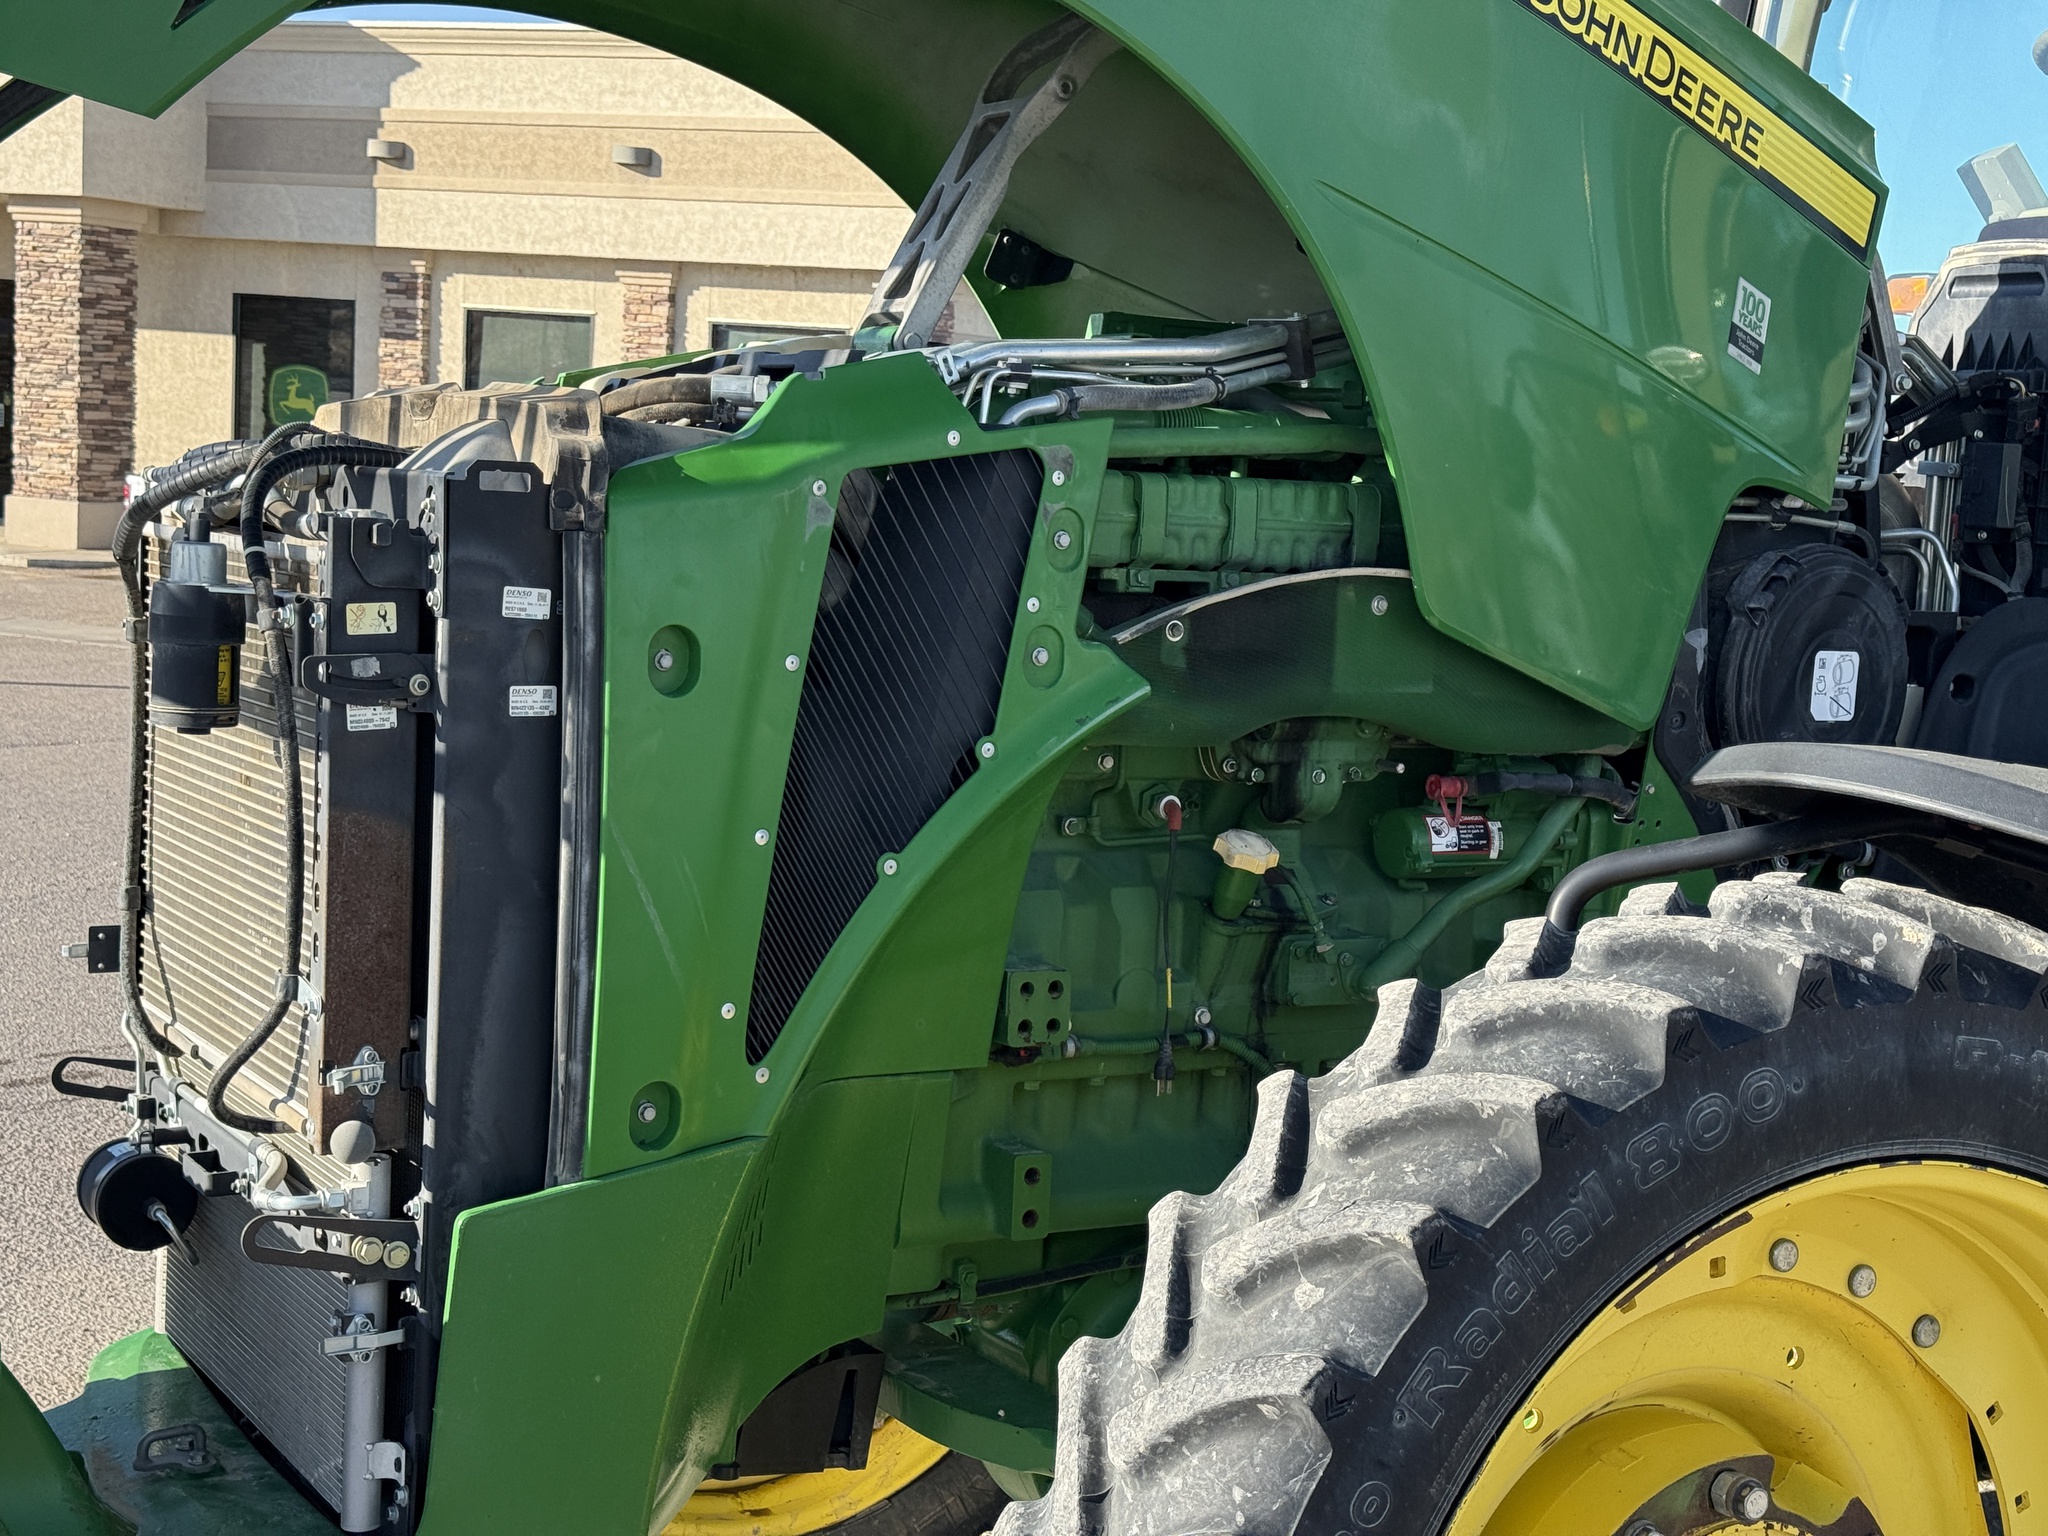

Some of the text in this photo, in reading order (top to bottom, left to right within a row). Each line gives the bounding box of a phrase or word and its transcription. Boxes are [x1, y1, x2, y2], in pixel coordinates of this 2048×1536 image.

[1741, 285, 1766, 323] 100
[1738, 309, 1763, 338] YEARS
[1735, 328, 1760, 351] John Deere
[1738, 338, 1755, 356] Tractors
[506, 589, 533, 597] DENSO
[1396, 1067, 1786, 1431] Radial 800
